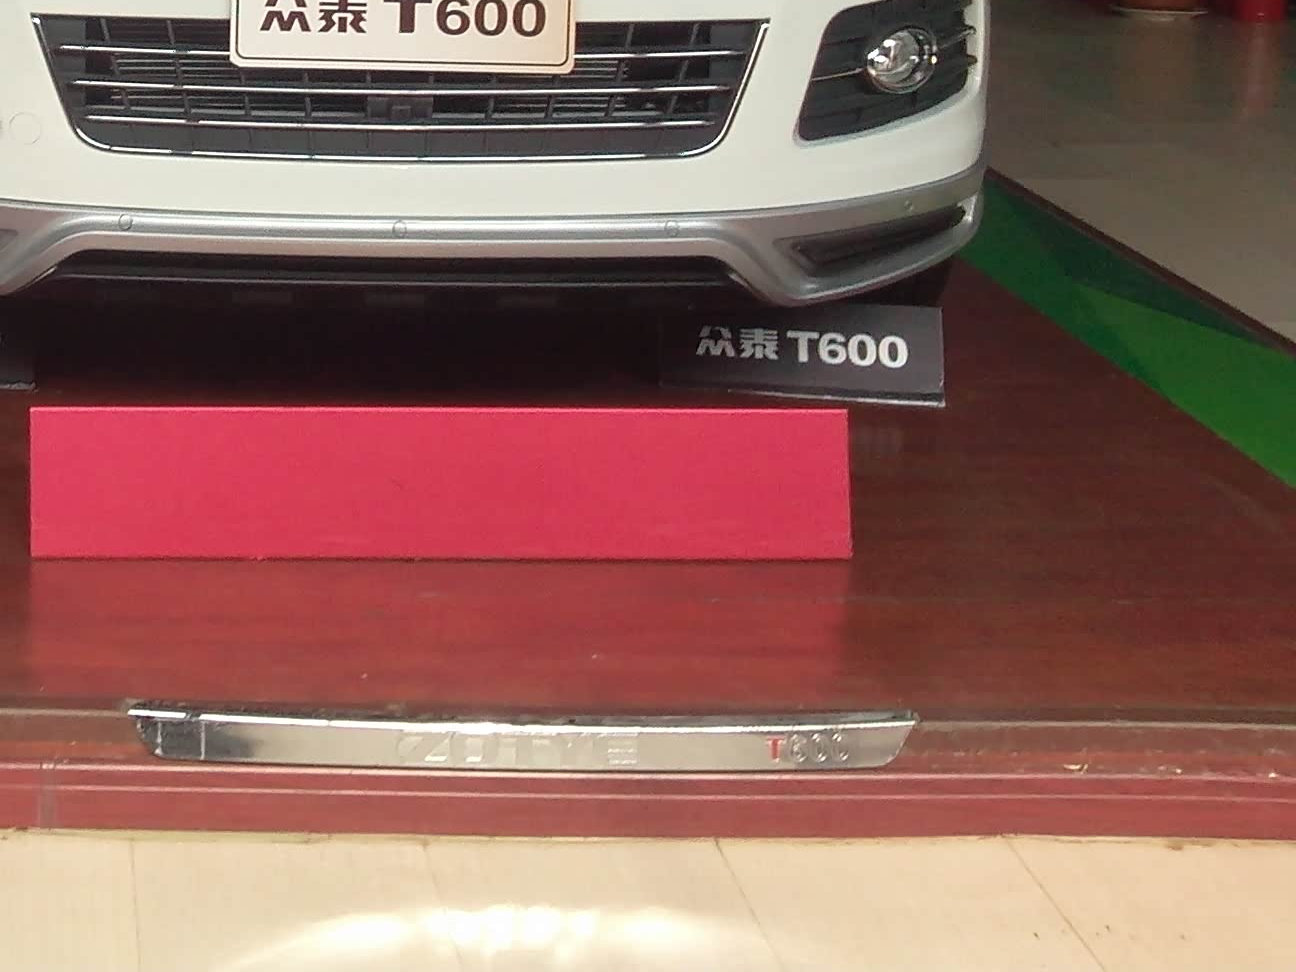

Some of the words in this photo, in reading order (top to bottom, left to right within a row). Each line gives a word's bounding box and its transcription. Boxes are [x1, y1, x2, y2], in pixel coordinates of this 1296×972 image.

[696, 325, 779, 360] 众泰
[786, 329, 909, 369] T600
[765, 732, 851, 764] T600
